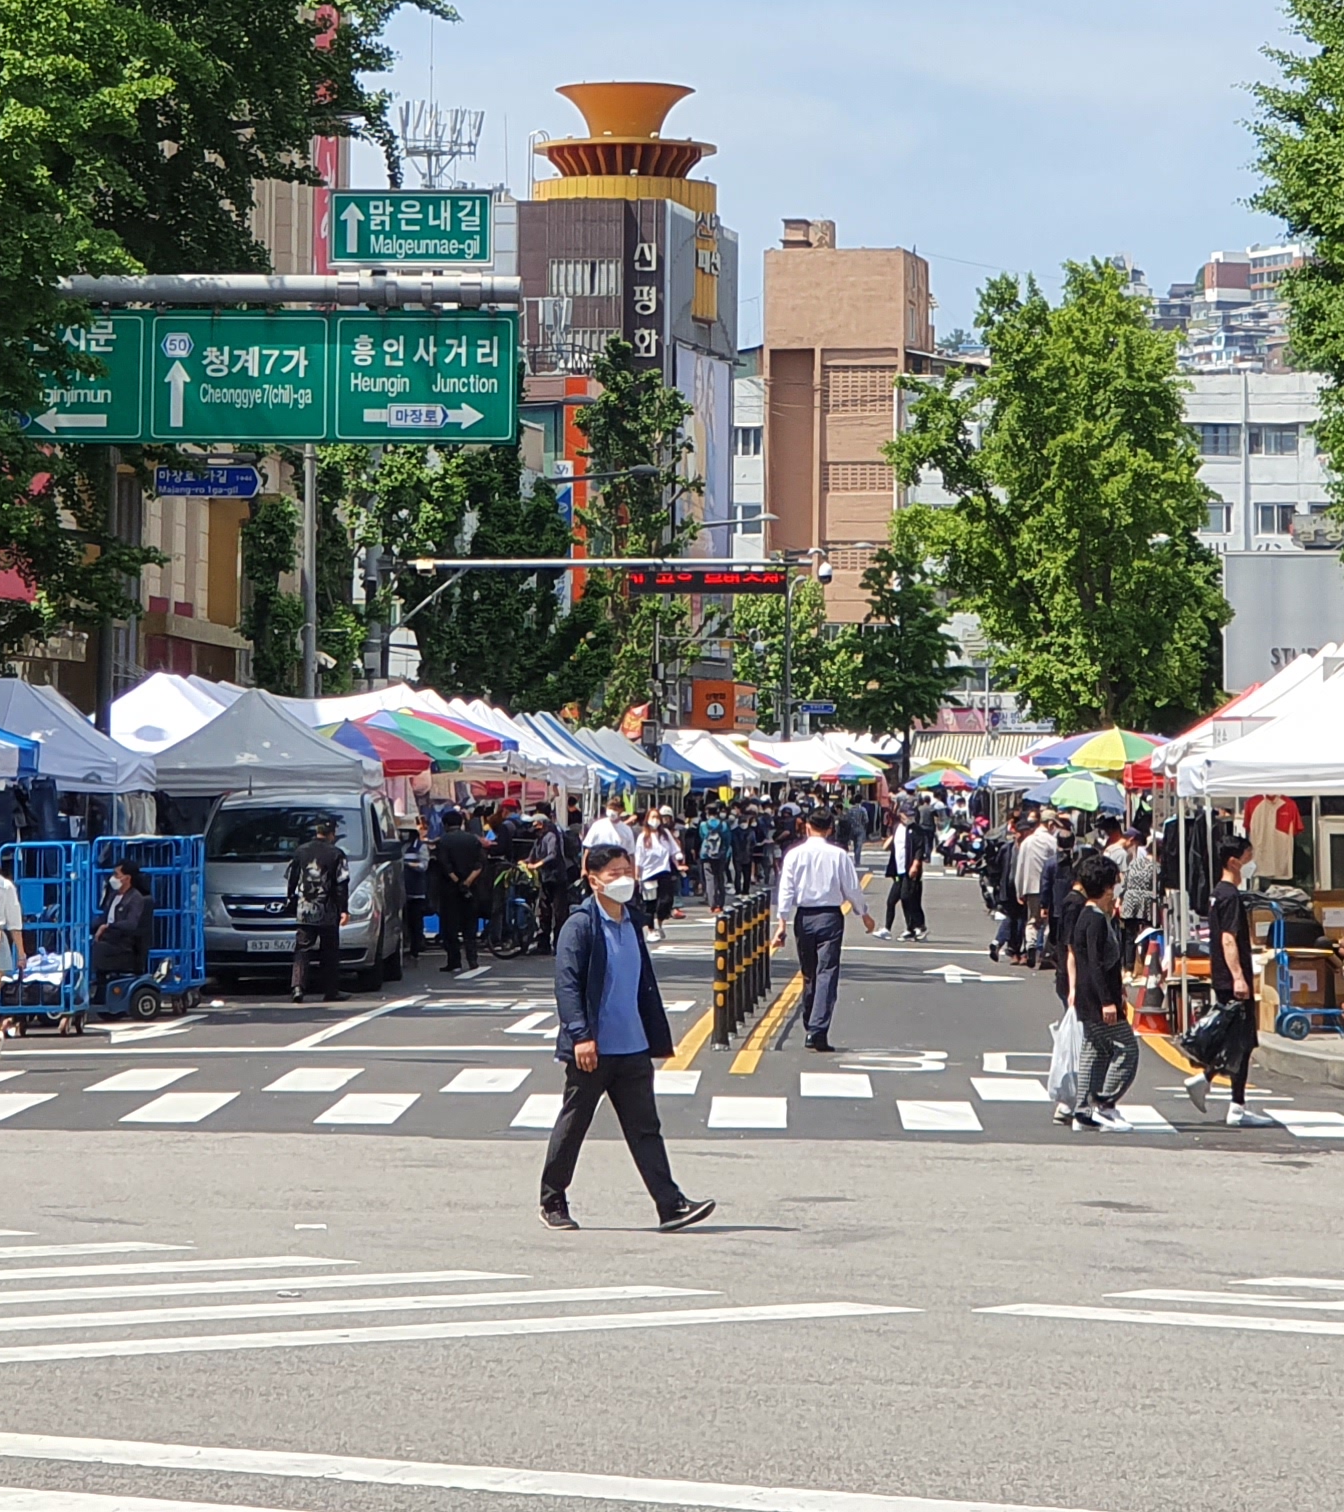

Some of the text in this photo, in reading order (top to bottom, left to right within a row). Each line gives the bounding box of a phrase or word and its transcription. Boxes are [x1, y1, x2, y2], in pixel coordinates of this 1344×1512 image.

[369, 199, 481, 232] 맑은내길
[370, 234, 481, 260] Malgeunnae-gil
[632, 242, 659, 358] 신평화
[168, 338, 187, 353] 50
[350, 335, 500, 368] 흥인사거리
[201, 347, 309, 378] 청계7가
[350, 372, 498, 397] Heungin Junction
[395, 407, 438, 427] 마장로
